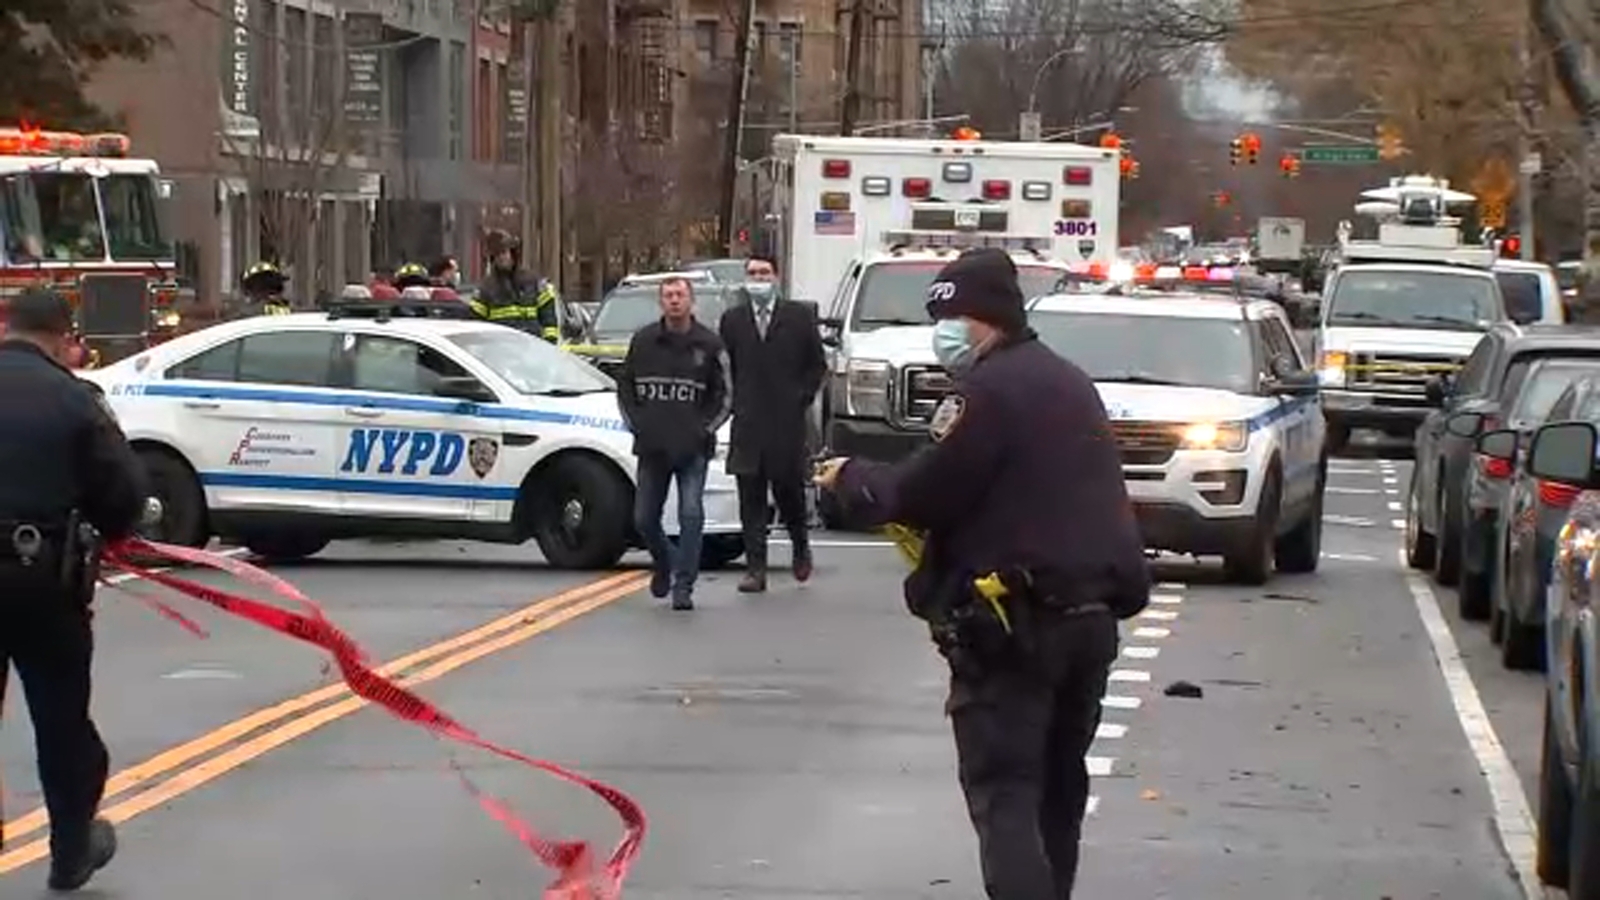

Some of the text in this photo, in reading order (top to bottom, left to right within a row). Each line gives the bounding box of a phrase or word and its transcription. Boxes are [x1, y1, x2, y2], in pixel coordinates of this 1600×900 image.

[234, 51, 248, 111] CENTER
[1054, 220, 1097, 236] 3801
[340, 429, 465, 476] NYPD
